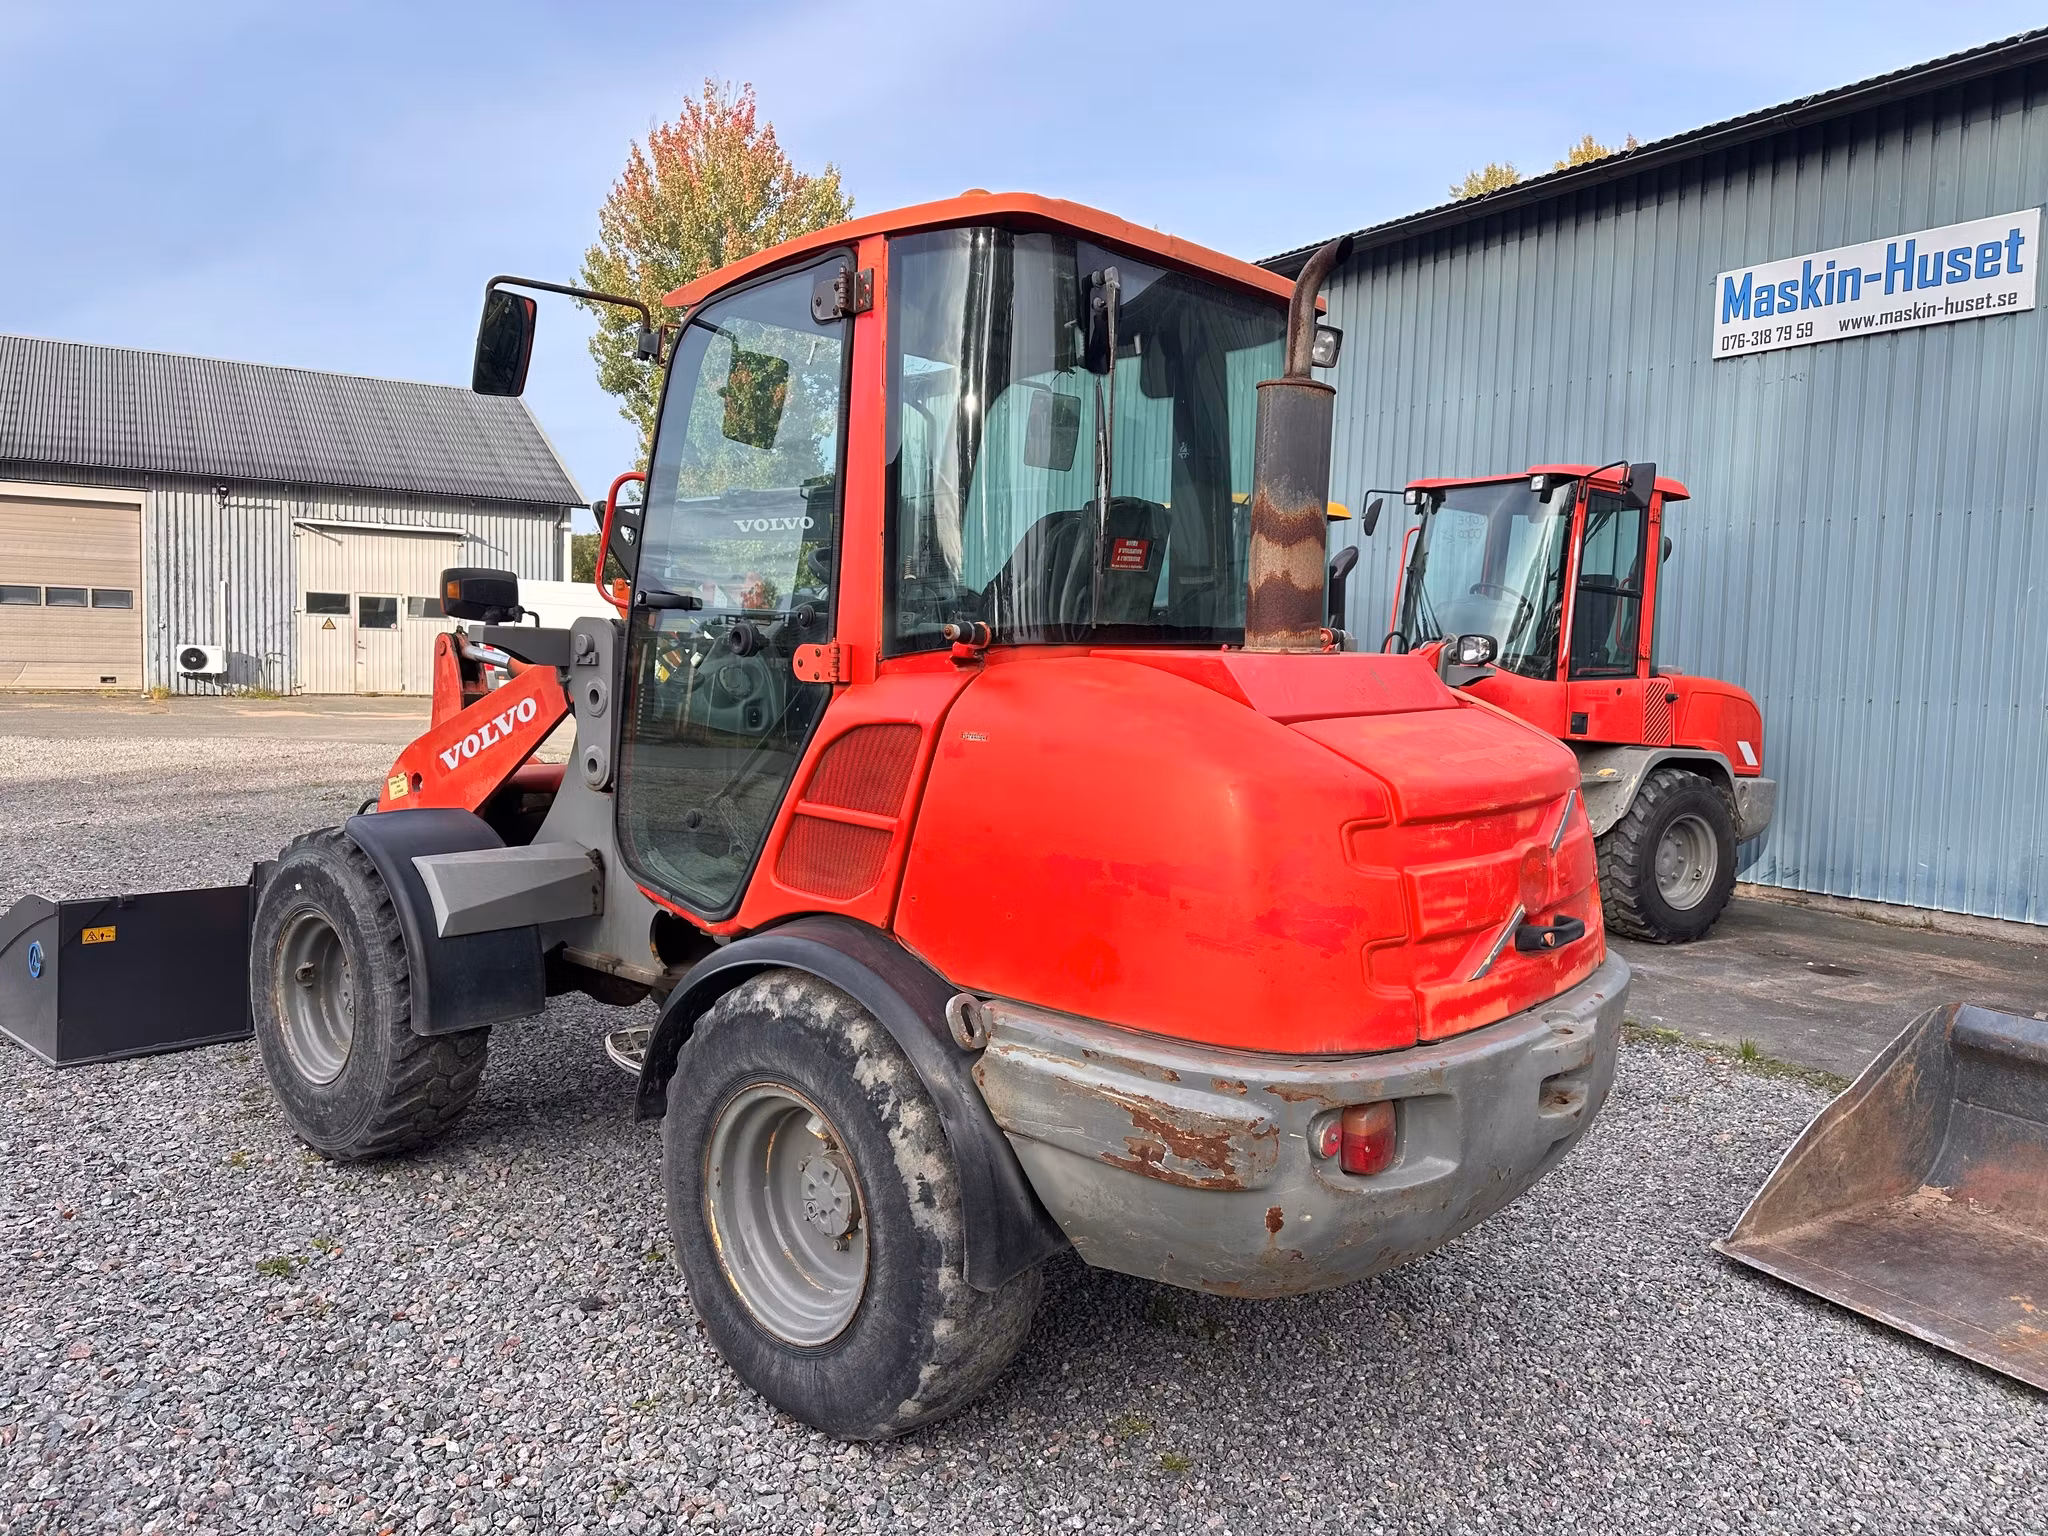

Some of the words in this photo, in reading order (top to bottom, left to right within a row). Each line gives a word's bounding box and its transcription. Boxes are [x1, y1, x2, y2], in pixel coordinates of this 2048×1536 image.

[1722, 228, 2025, 324] Maskin-Huset
[1838, 292, 2018, 332] www.maskin-huset.se
[1722, 331, 1772, 351] 076-318
[1776, 325, 1792, 343] 79
[1796, 321, 1814, 339] 59
[733, 516, 815, 533] VOLVO
[439, 697, 537, 771] VOLVO
